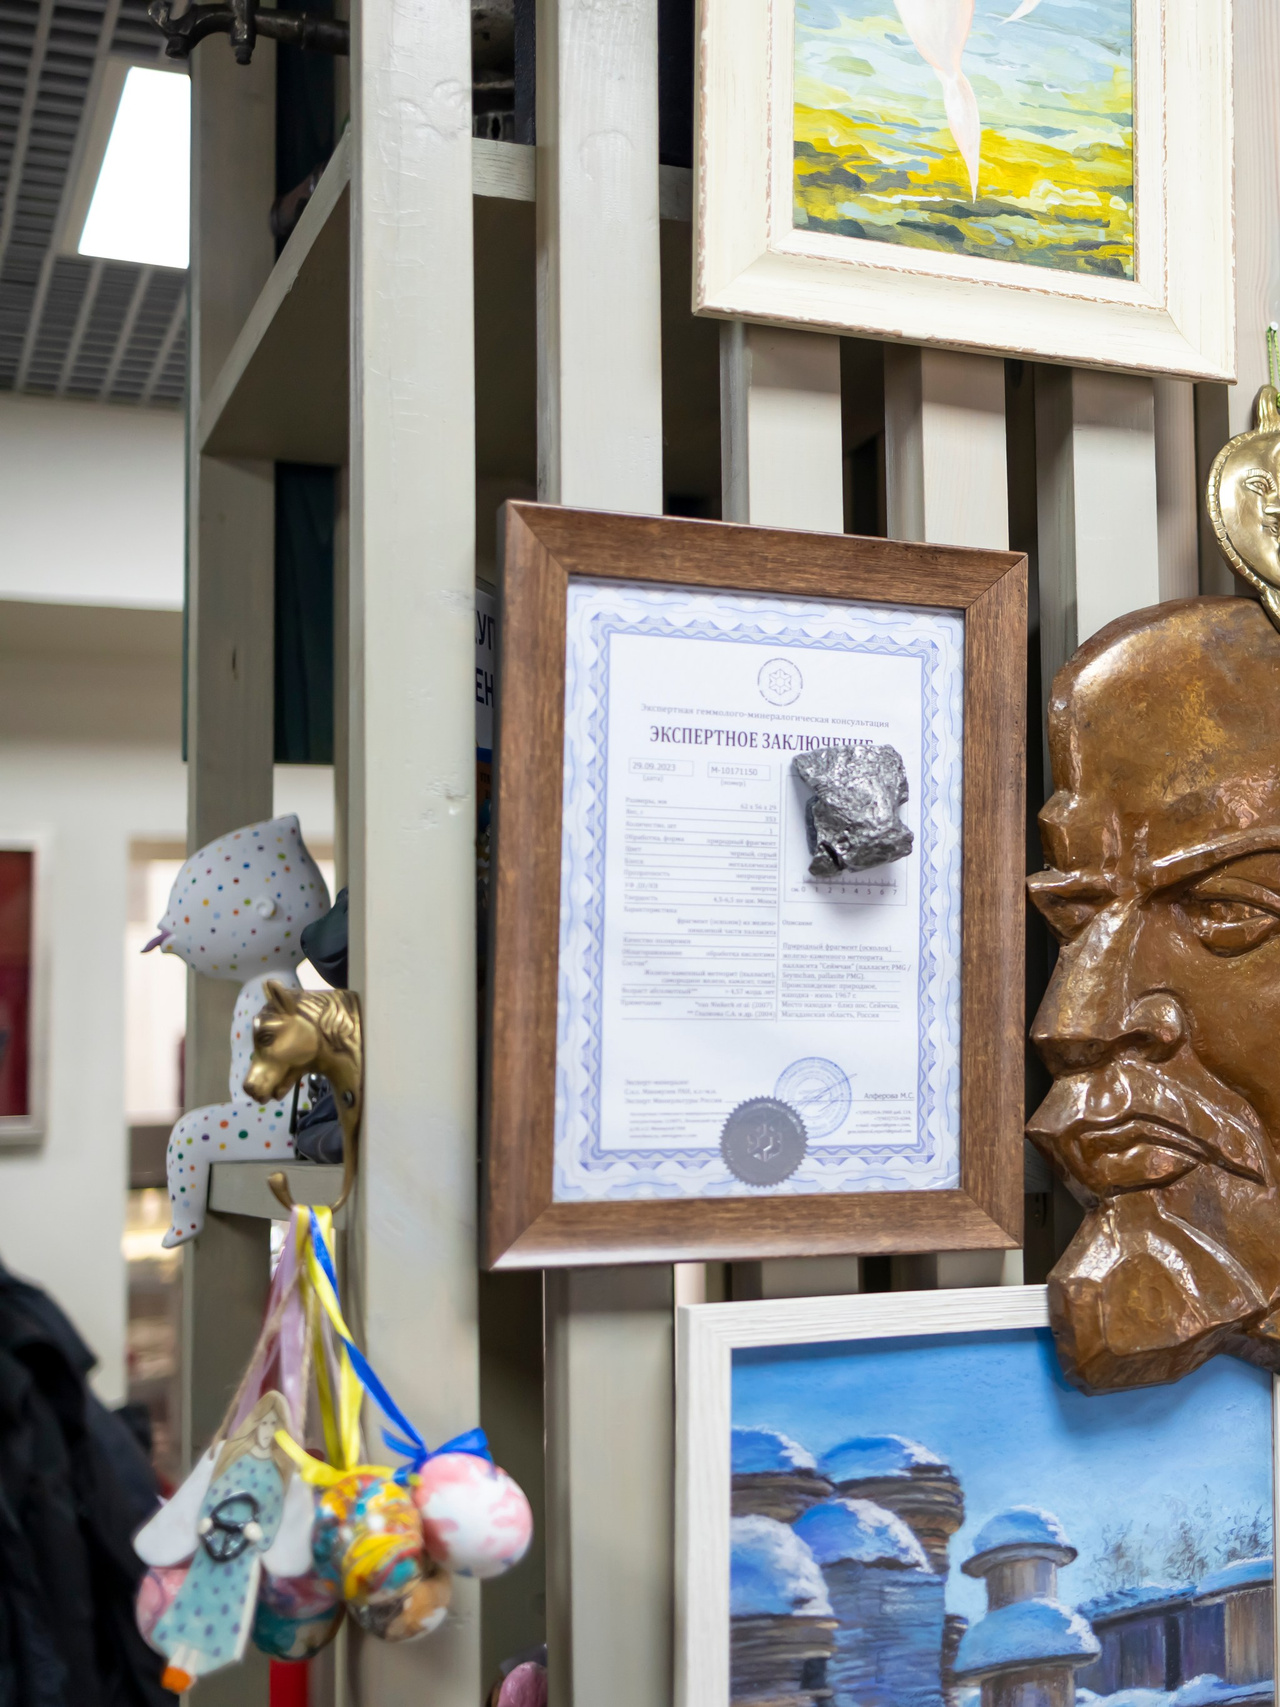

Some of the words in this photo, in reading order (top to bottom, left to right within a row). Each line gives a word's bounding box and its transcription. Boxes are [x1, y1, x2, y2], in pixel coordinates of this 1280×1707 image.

[641, 704, 693, 716] Экспертная
[696, 708, 829, 725] геммолого-минералогическая
[831, 717, 889, 728] консультация
[650, 725, 758, 748] ЭКСПЕРТНОЕ
[632, 761, 676, 772] 29.09.2023
[782, 942, 823, 951] Природный
[825, 943, 858, 952] фрагмент
[834, 991, 851, 999] 1967
[863, 1092, 899, 1101] Алферова
[900, 1091, 914, 1099] М.С.
